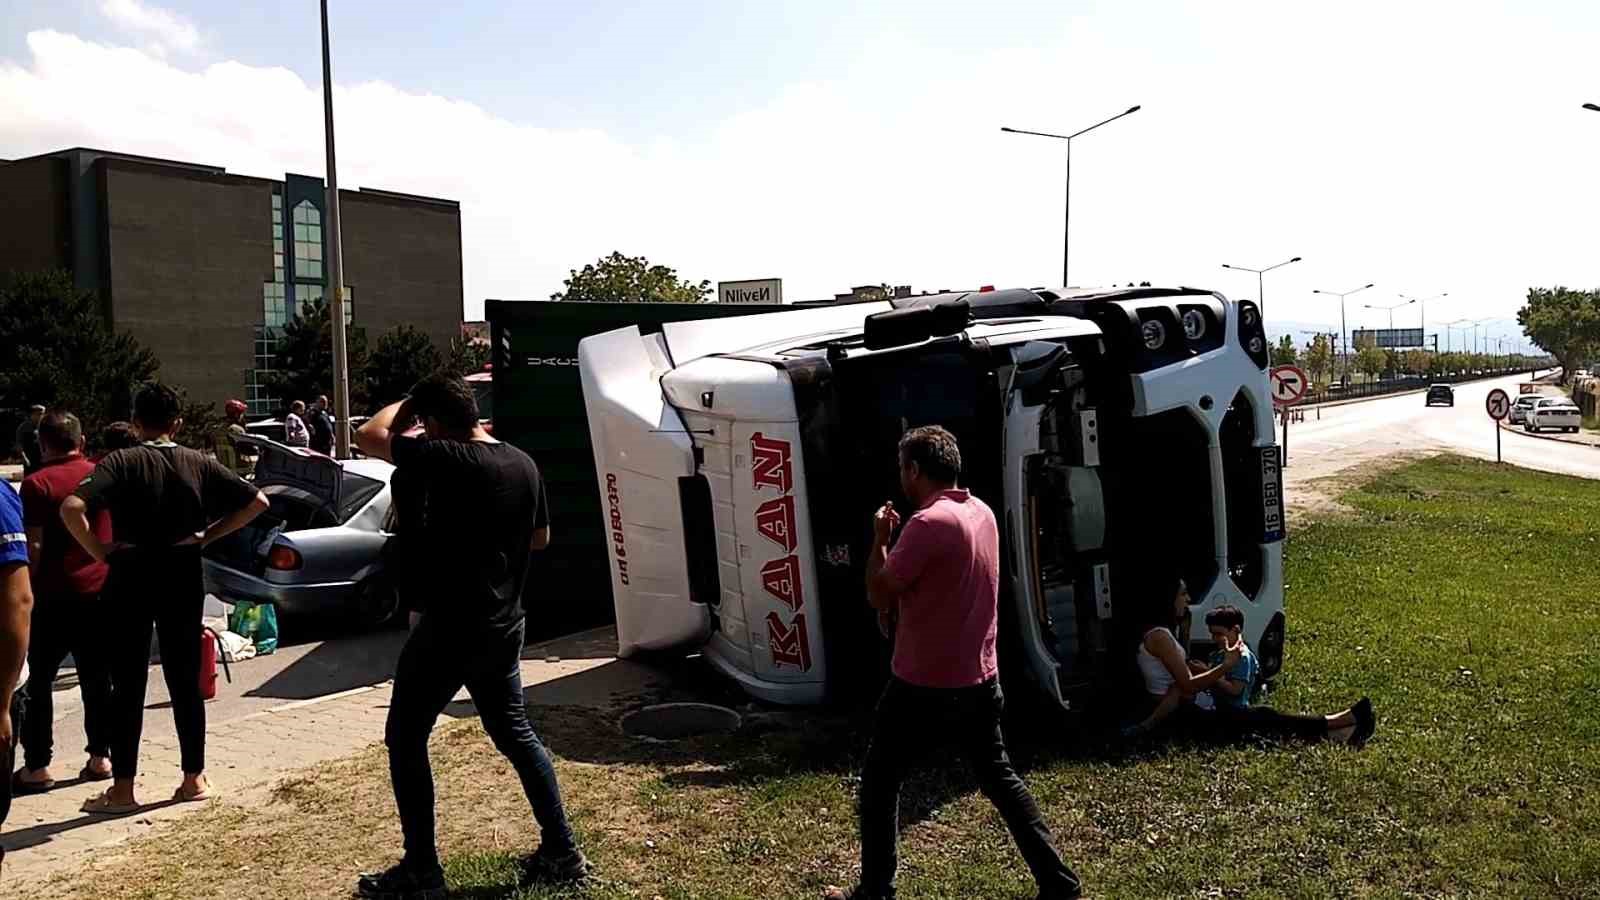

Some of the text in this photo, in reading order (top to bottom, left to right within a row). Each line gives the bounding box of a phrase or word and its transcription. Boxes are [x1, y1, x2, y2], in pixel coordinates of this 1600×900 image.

[750, 431, 812, 673] KAAN
[1262, 448, 1280, 531] 16 BED 370
